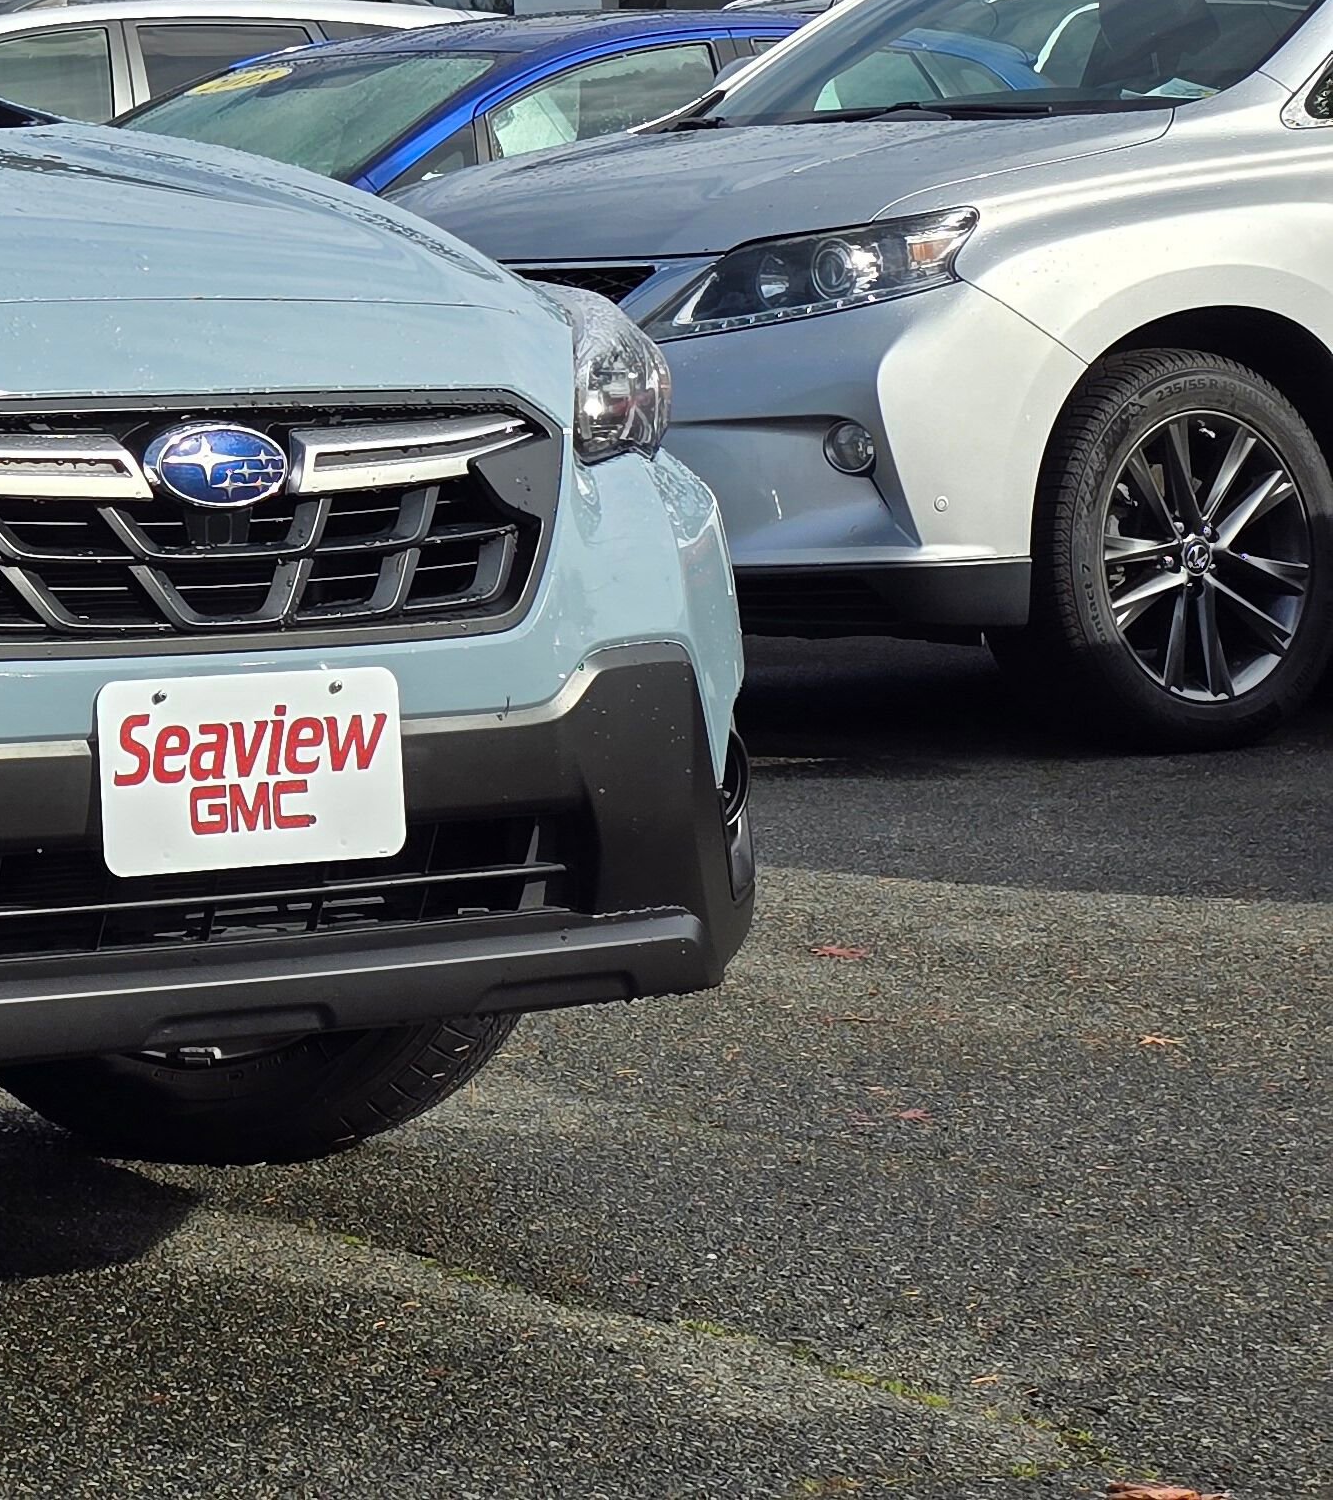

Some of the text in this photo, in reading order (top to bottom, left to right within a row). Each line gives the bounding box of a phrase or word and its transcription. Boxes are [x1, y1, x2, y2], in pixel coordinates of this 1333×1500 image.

[1155, 378, 1207, 403] 235/55
[1084, 582, 1108, 645] ontact
[113, 705, 388, 787] Seaview
[189, 779, 317, 836] GMC
